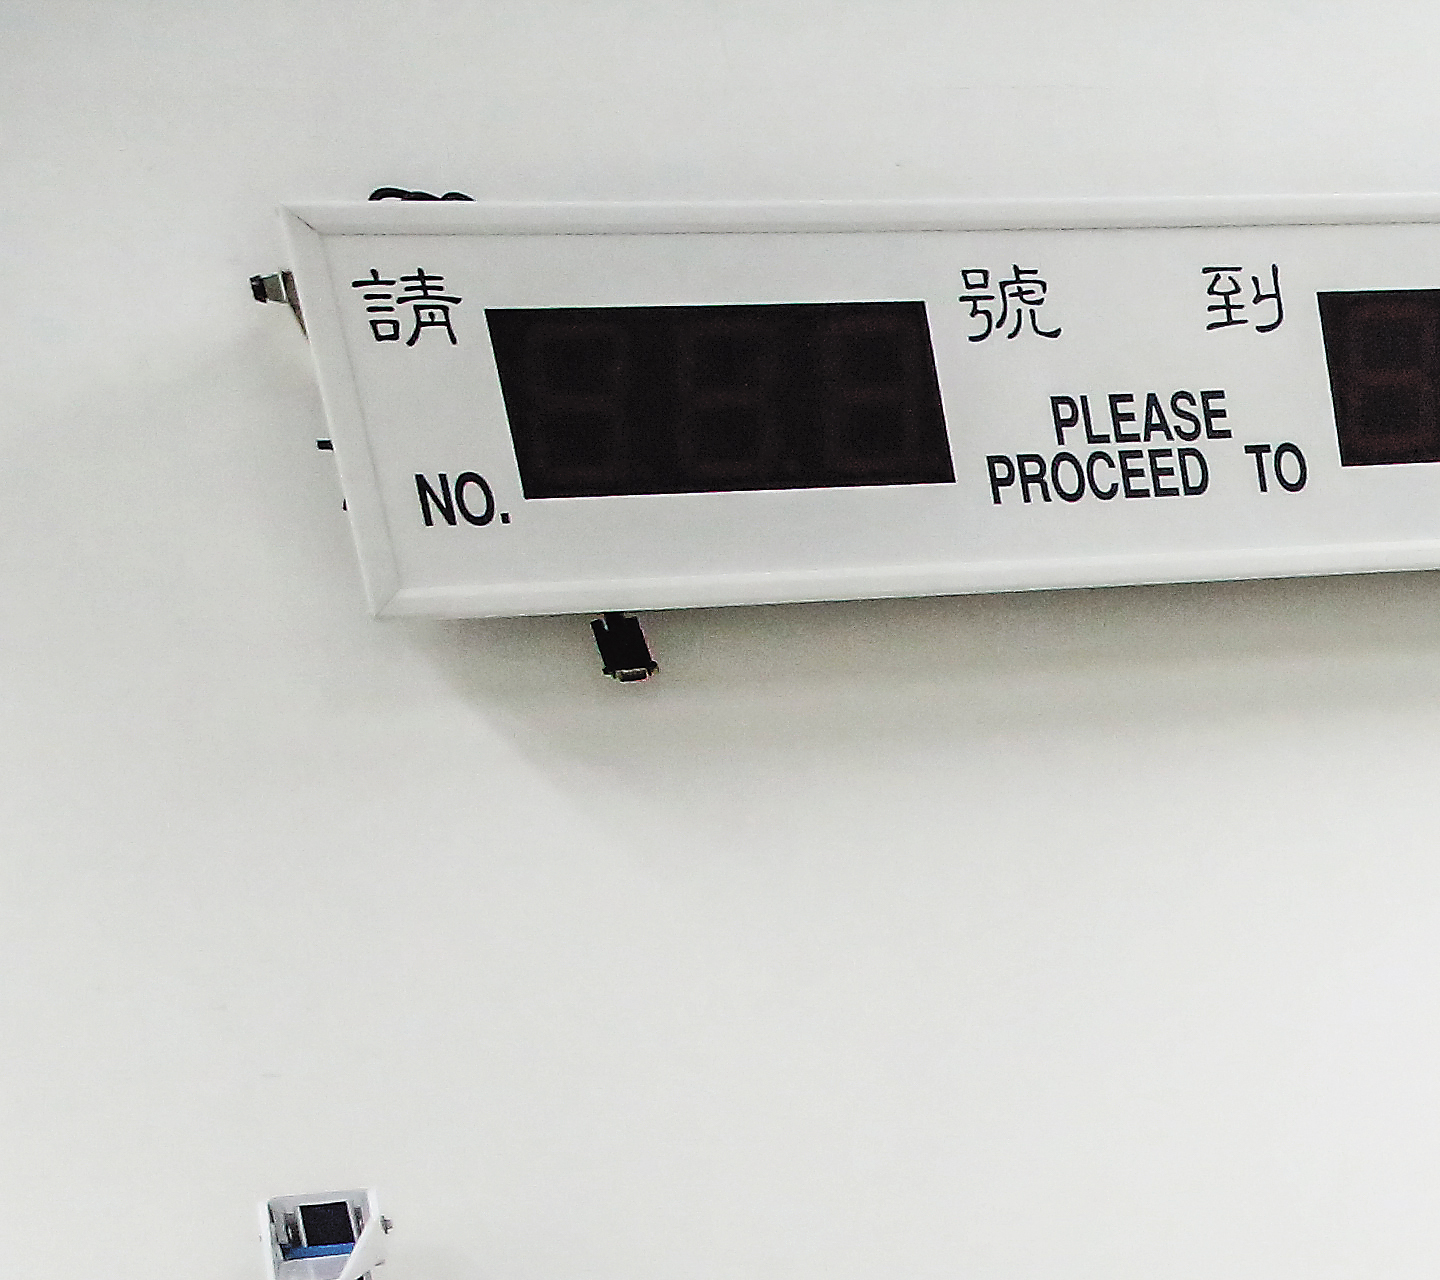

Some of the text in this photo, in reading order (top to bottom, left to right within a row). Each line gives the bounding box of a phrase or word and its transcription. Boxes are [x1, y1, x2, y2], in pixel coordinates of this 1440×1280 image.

[352, 268, 462, 347] 請
[959, 264, 1061, 342] 號
[1201, 264, 1283, 334] 到
[1051, 389, 1232, 445] PLEASE
[414, 471, 511, 527] NO.
[986, 443, 1308, 504] PROCEED TO
